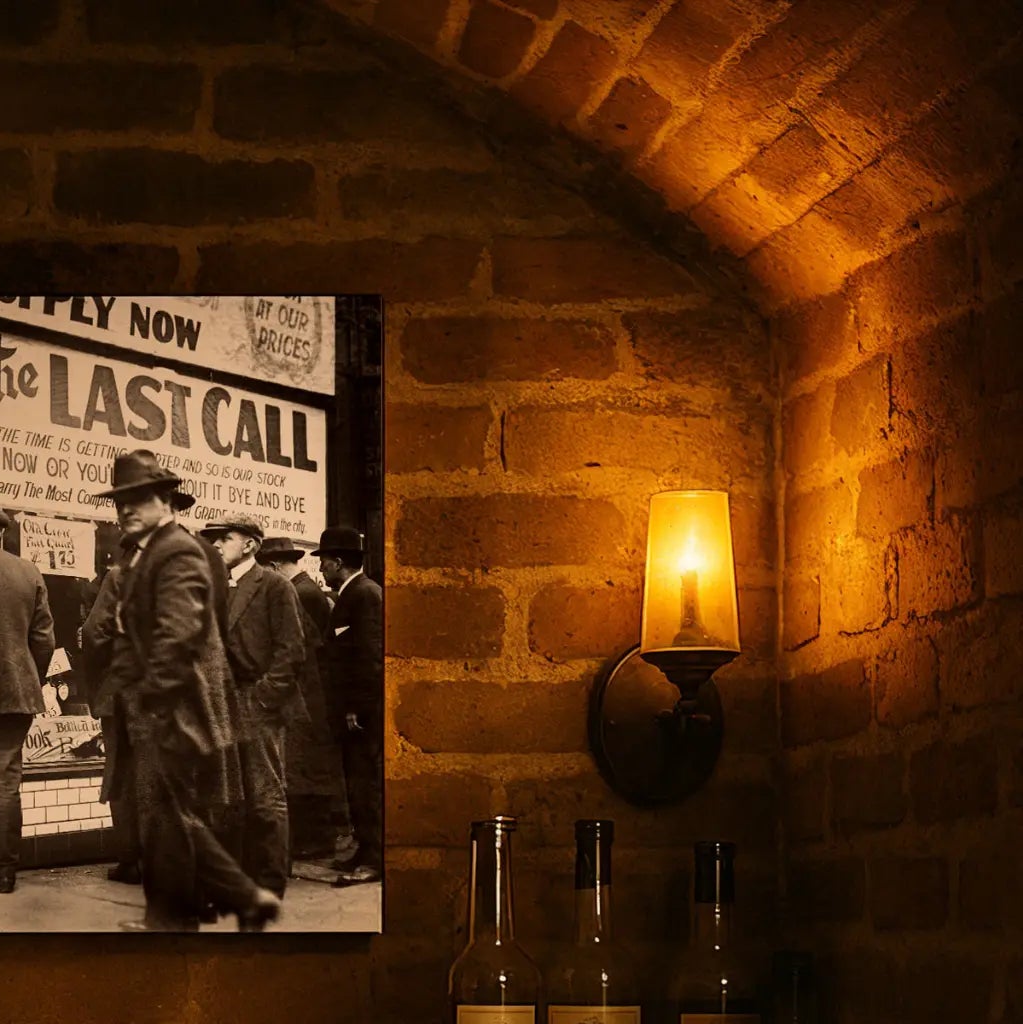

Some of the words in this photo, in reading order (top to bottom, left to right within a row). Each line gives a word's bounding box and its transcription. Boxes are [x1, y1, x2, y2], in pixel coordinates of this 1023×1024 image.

[130, 302, 201, 352] NOW
[256, 298, 273, 320] AT
[278, 304, 309, 331] OUR
[256, 326, 311, 361] PRICES
[49, 353, 192, 449] LAST
[201, 386, 318, 473] CALL
[2, 447, 37, 474] NOW
[46, 457, 68, 480] OR
[213, 484, 223, 500] IT
[229, 486, 252, 506] BYE
[256, 491, 280, 510] AND
[284, 494, 306, 513] BYE
[24, 431, 54, 450] TIME
[58, 437, 71, 452] IS
[182, 459, 203, 474] AND
[205, 463, 219, 476] SO
[221, 466, 231, 479] IS
[232, 468, 253, 483] OUR
[257, 472, 286, 487] STOCK
[24, 481, 43, 499] The
[46, 484, 73, 502] Most
